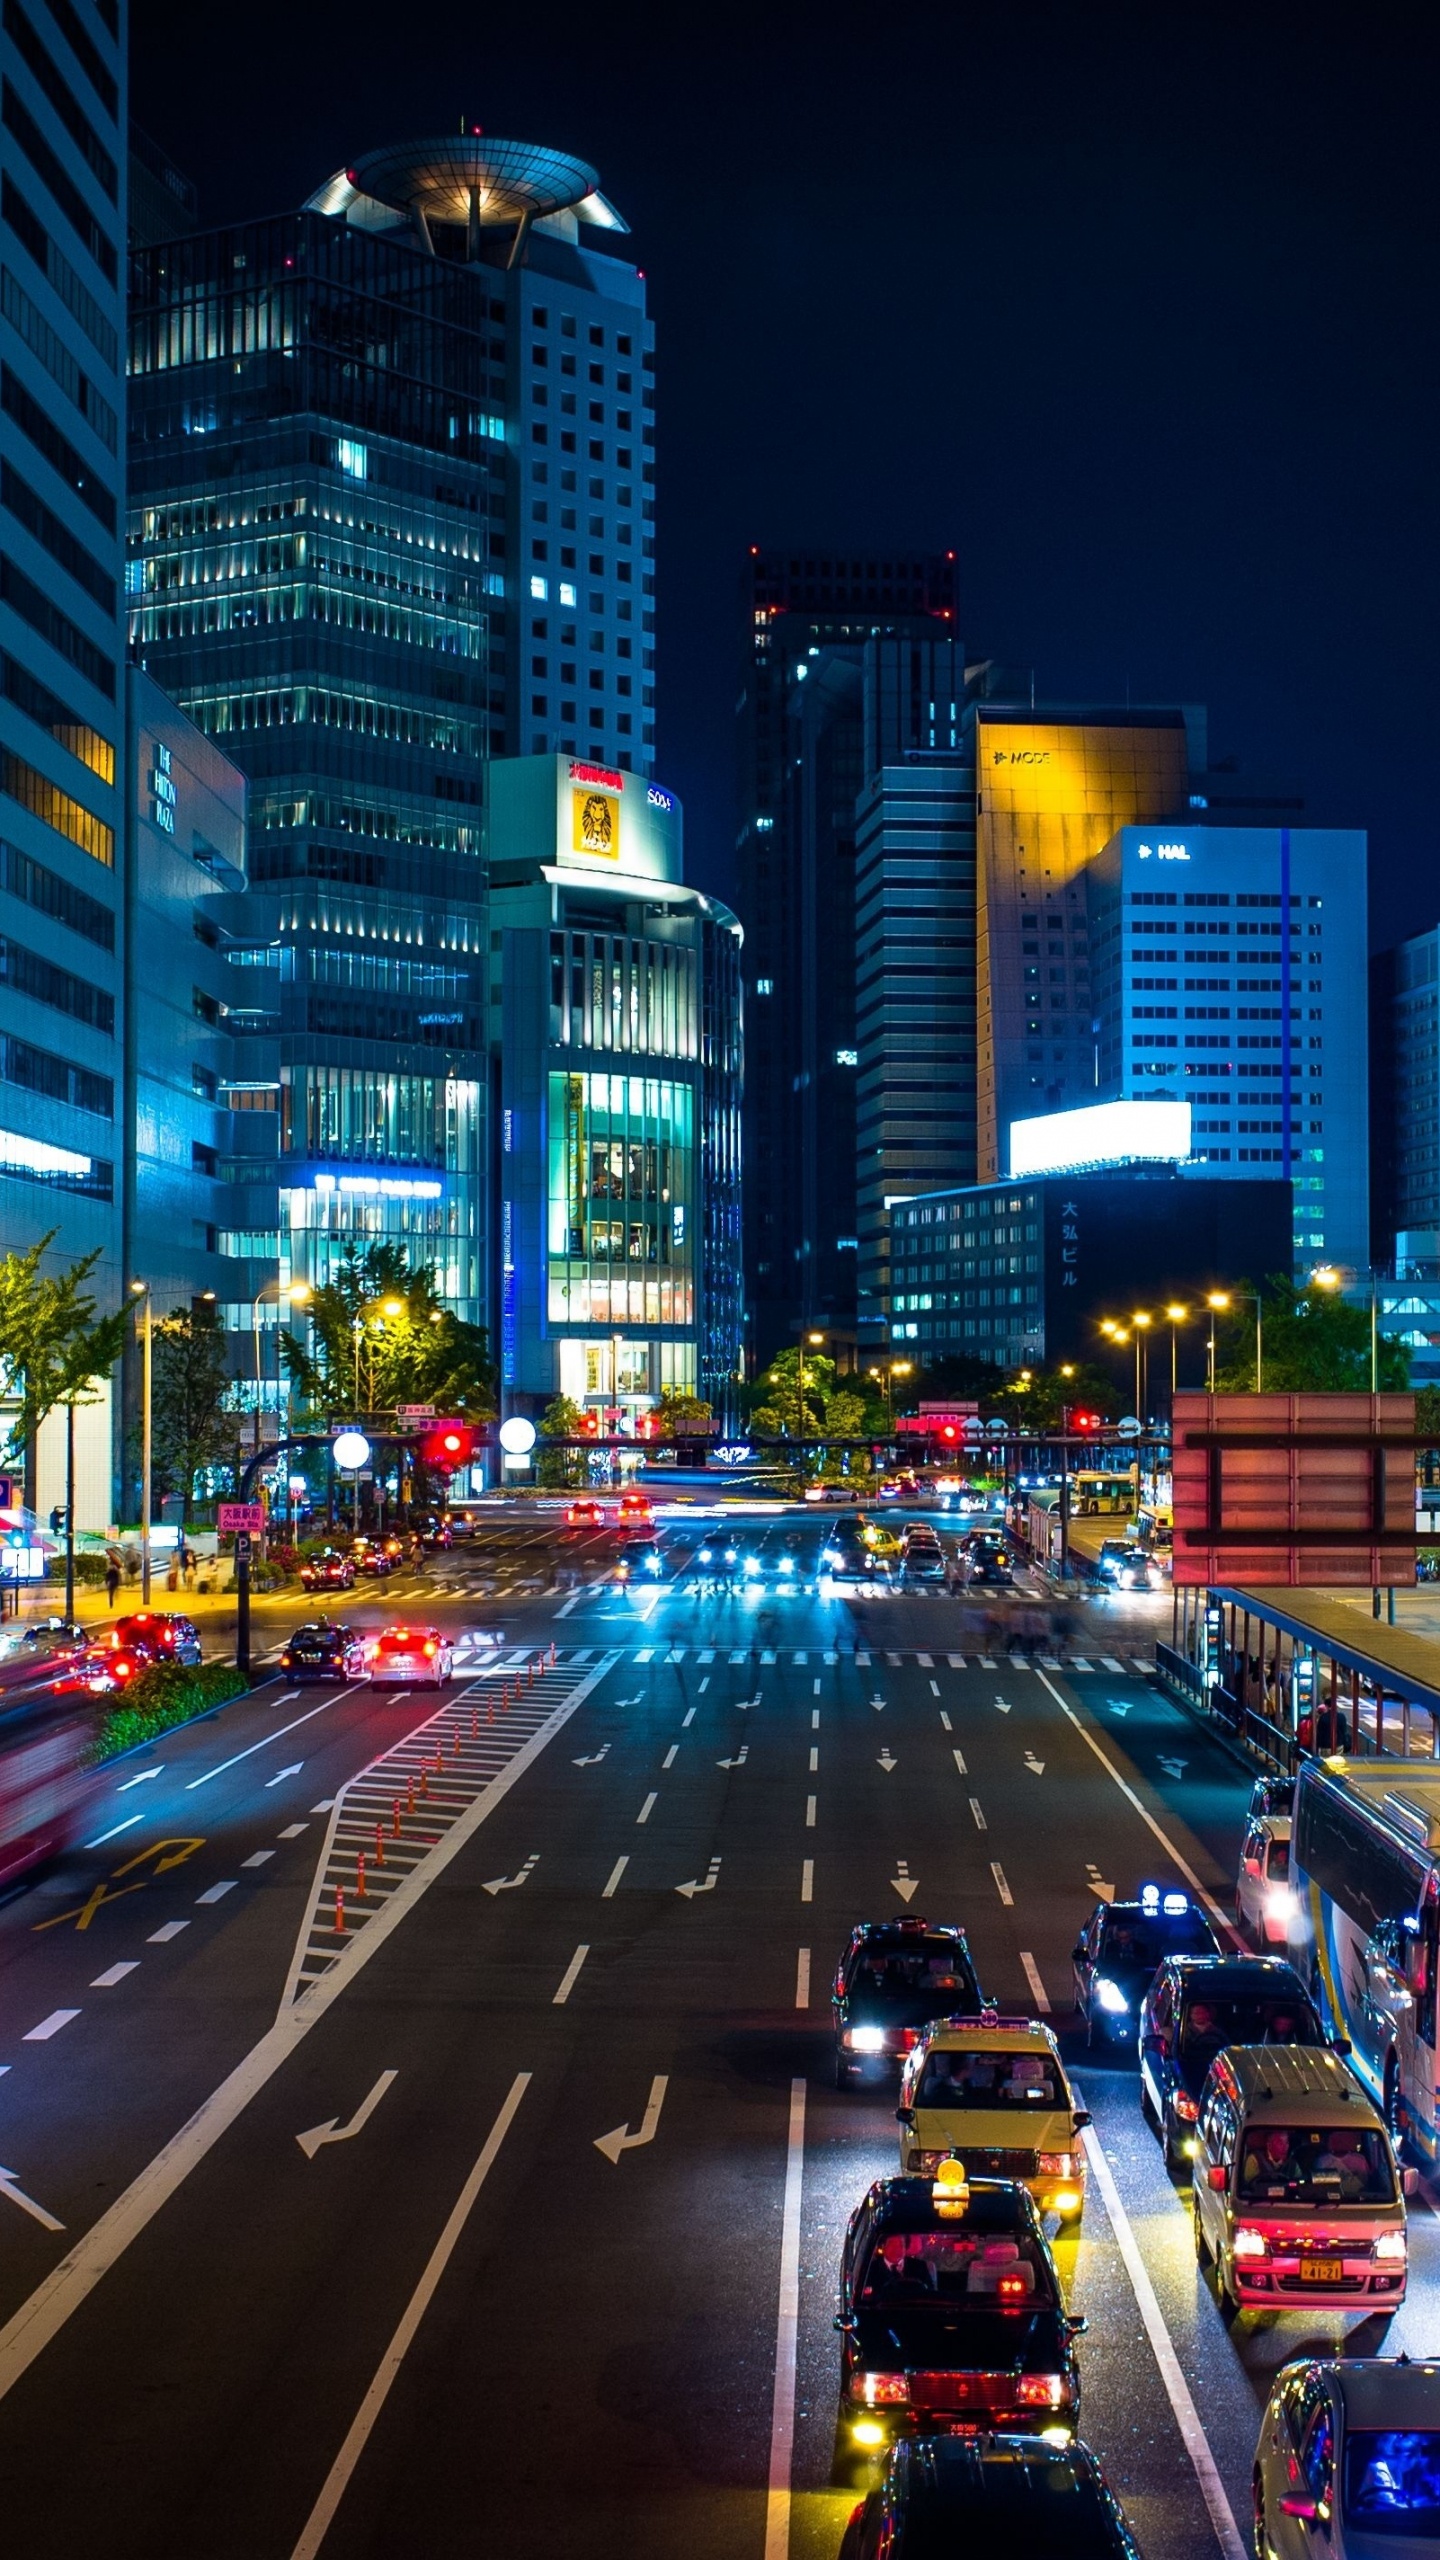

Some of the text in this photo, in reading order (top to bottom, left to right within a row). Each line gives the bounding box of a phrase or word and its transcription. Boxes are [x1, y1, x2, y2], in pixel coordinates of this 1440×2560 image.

[159, 744, 171, 775] THE
[1010, 752, 1050, 765] MODE
[1157, 844, 1191, 860] HAL
[1062, 1202, 1078, 1286] 大弘ビル
[223, 1507, 260, 1520] 大阪駅前
[238, 1538, 248, 1552] P
